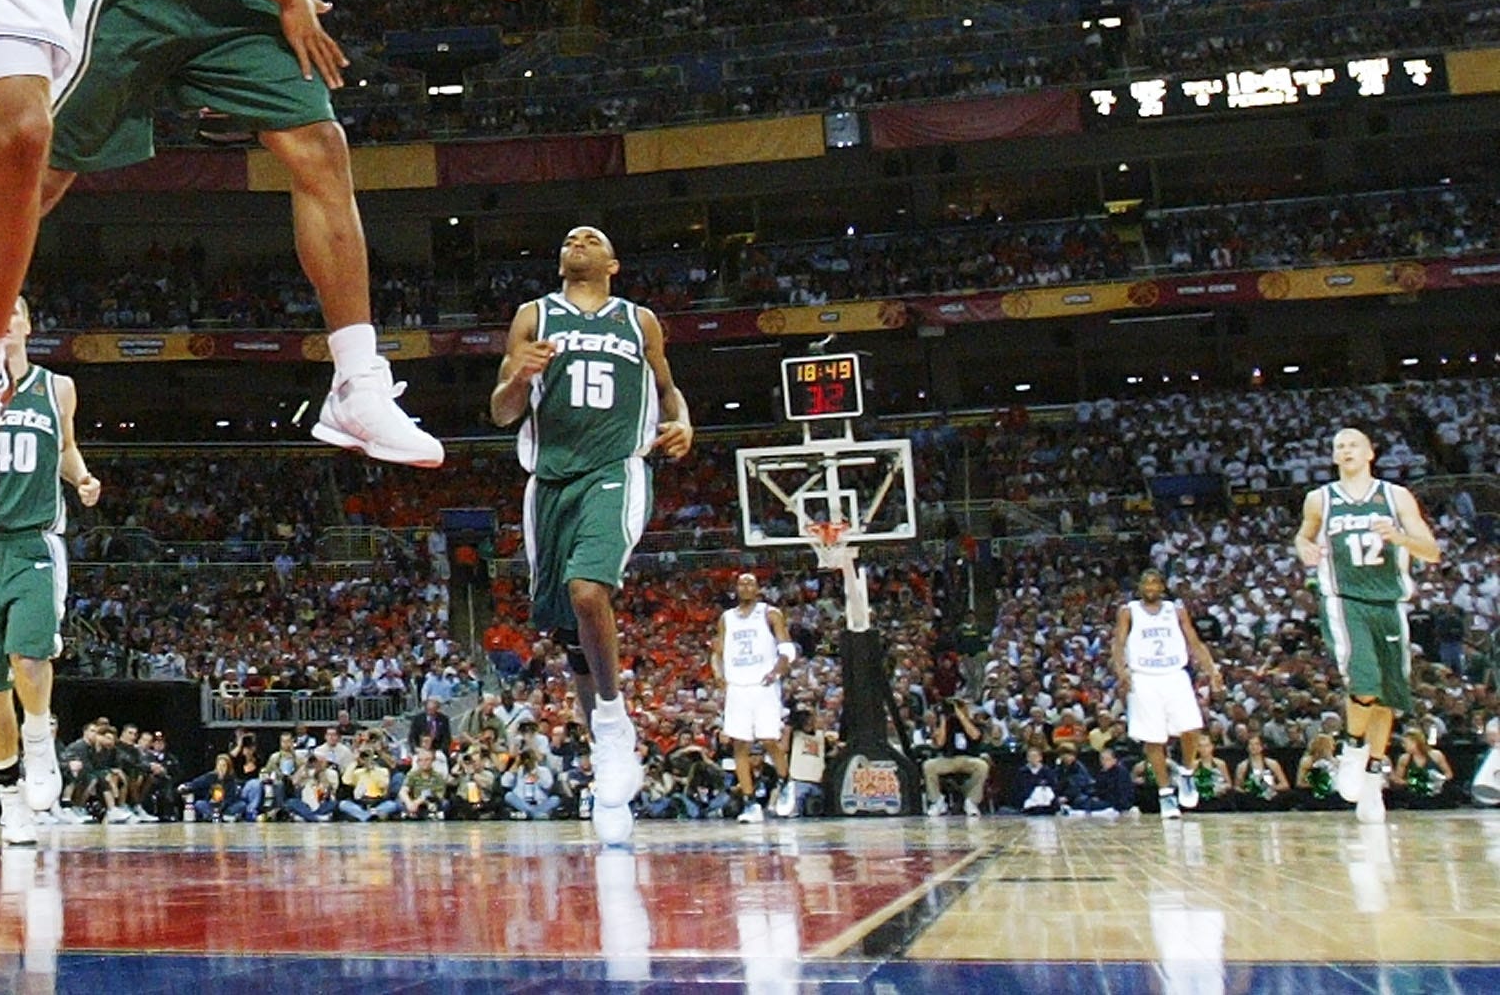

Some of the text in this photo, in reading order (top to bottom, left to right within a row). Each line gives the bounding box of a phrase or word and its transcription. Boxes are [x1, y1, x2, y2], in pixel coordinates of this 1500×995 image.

[548, 330, 640, 364] State
[566, 360, 614, 409] 15
[797, 361, 852, 382] 18:49
[1344, 532, 1385, 566] 12
[739, 640, 752, 654] 21
[1153, 640, 1164, 656] 2
